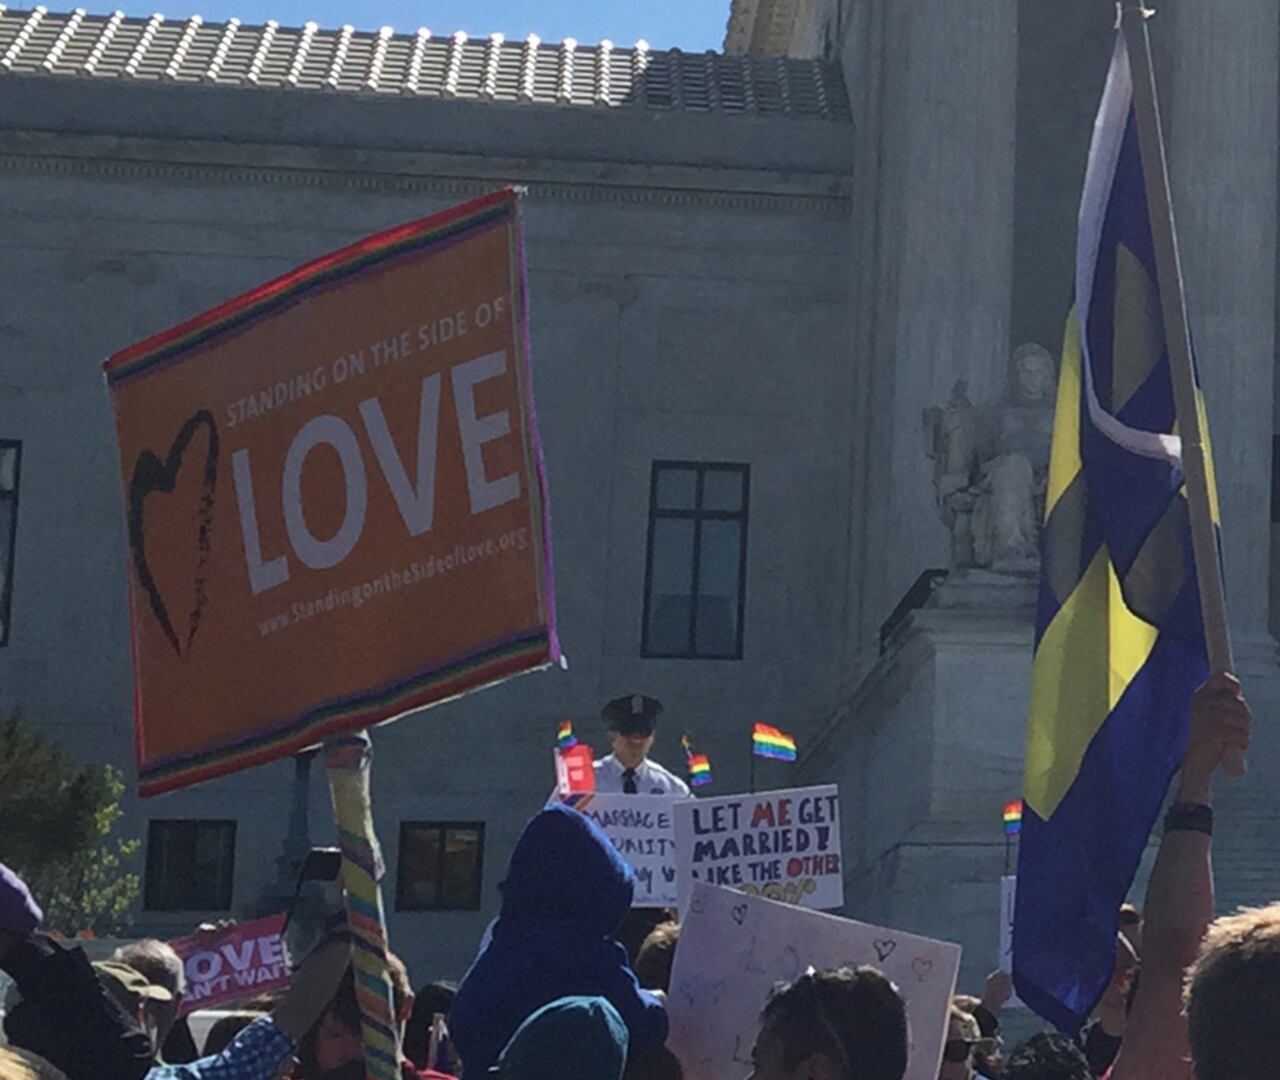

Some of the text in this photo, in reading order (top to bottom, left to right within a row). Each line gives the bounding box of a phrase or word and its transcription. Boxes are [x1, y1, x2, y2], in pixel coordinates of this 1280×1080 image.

[226, 296, 505, 428] STANDING ON THE SIDE OF
[231, 350, 523, 595] LOVE
[692, 795, 838, 835] LET ME GET
[747, 860, 782, 882] THE
[786, 853, 840, 878] OTHER
[184, 933, 282, 982] OVE
[183, 974, 231, 1001] AN'T
